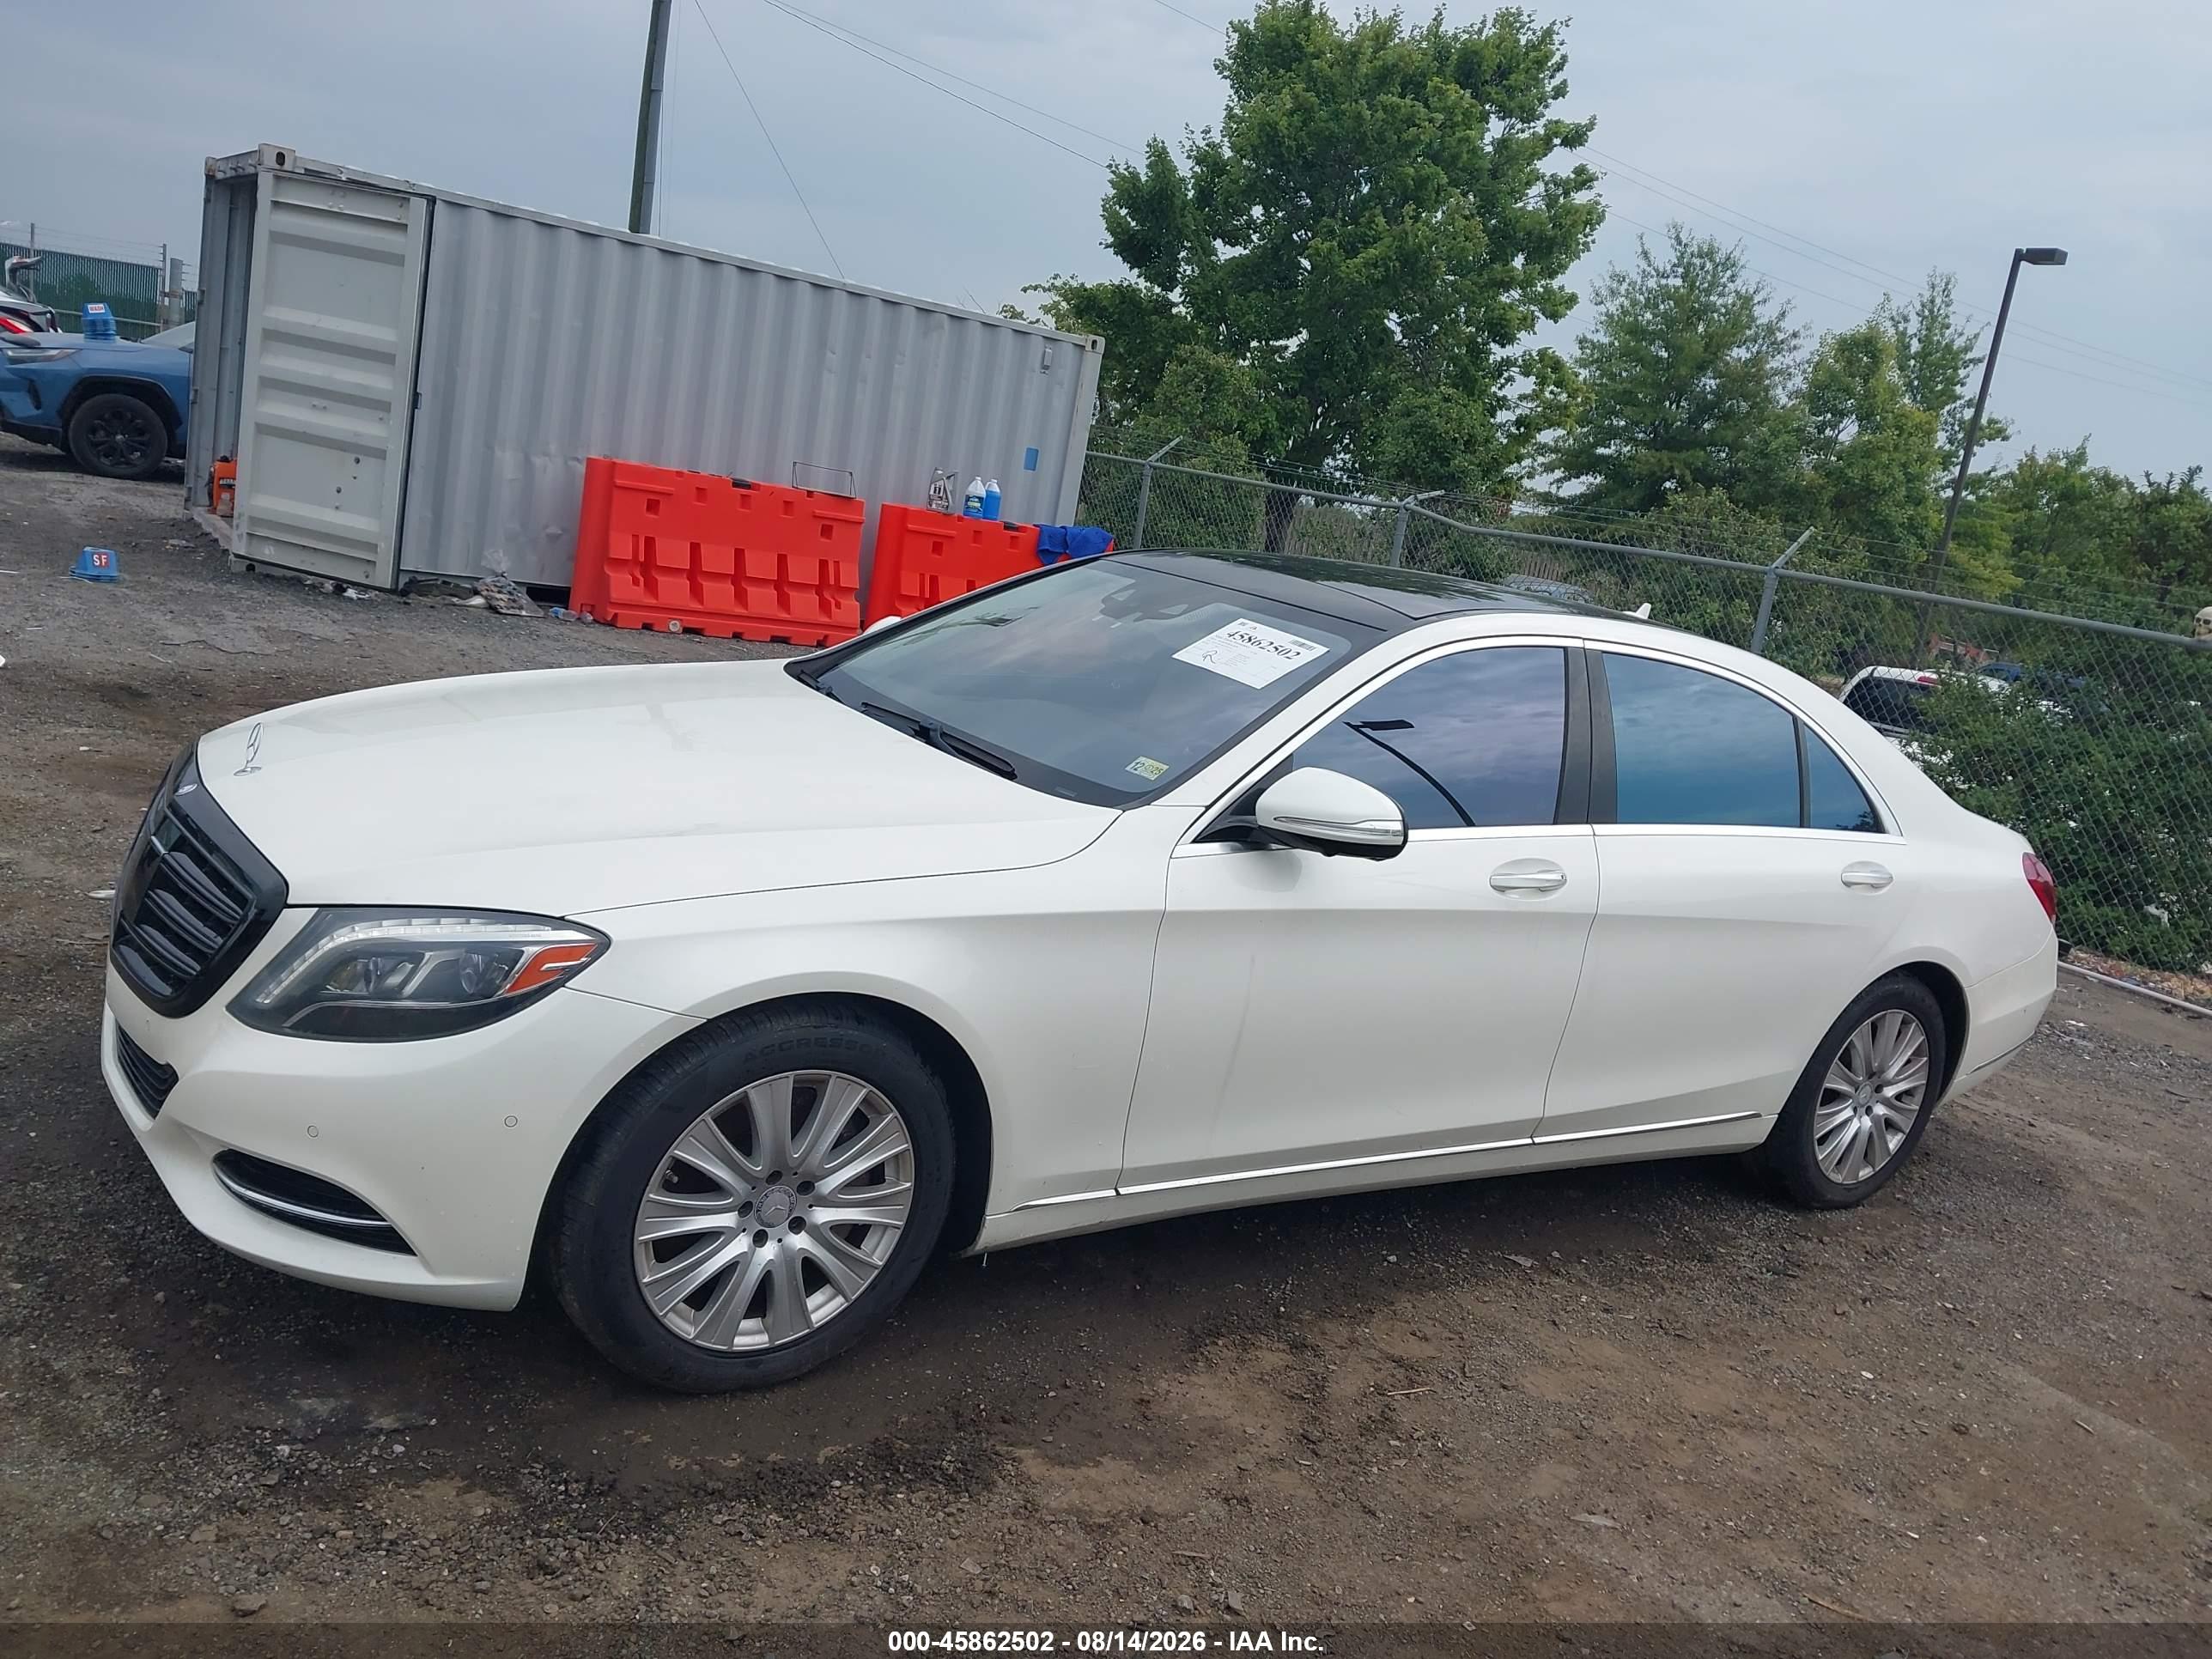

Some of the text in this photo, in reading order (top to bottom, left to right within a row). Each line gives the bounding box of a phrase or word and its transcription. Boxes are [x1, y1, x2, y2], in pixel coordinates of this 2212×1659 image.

[93, 554, 108, 567] SF
[1226, 630, 1302, 660] 45862502
[1130, 761, 1145, 771] 12
